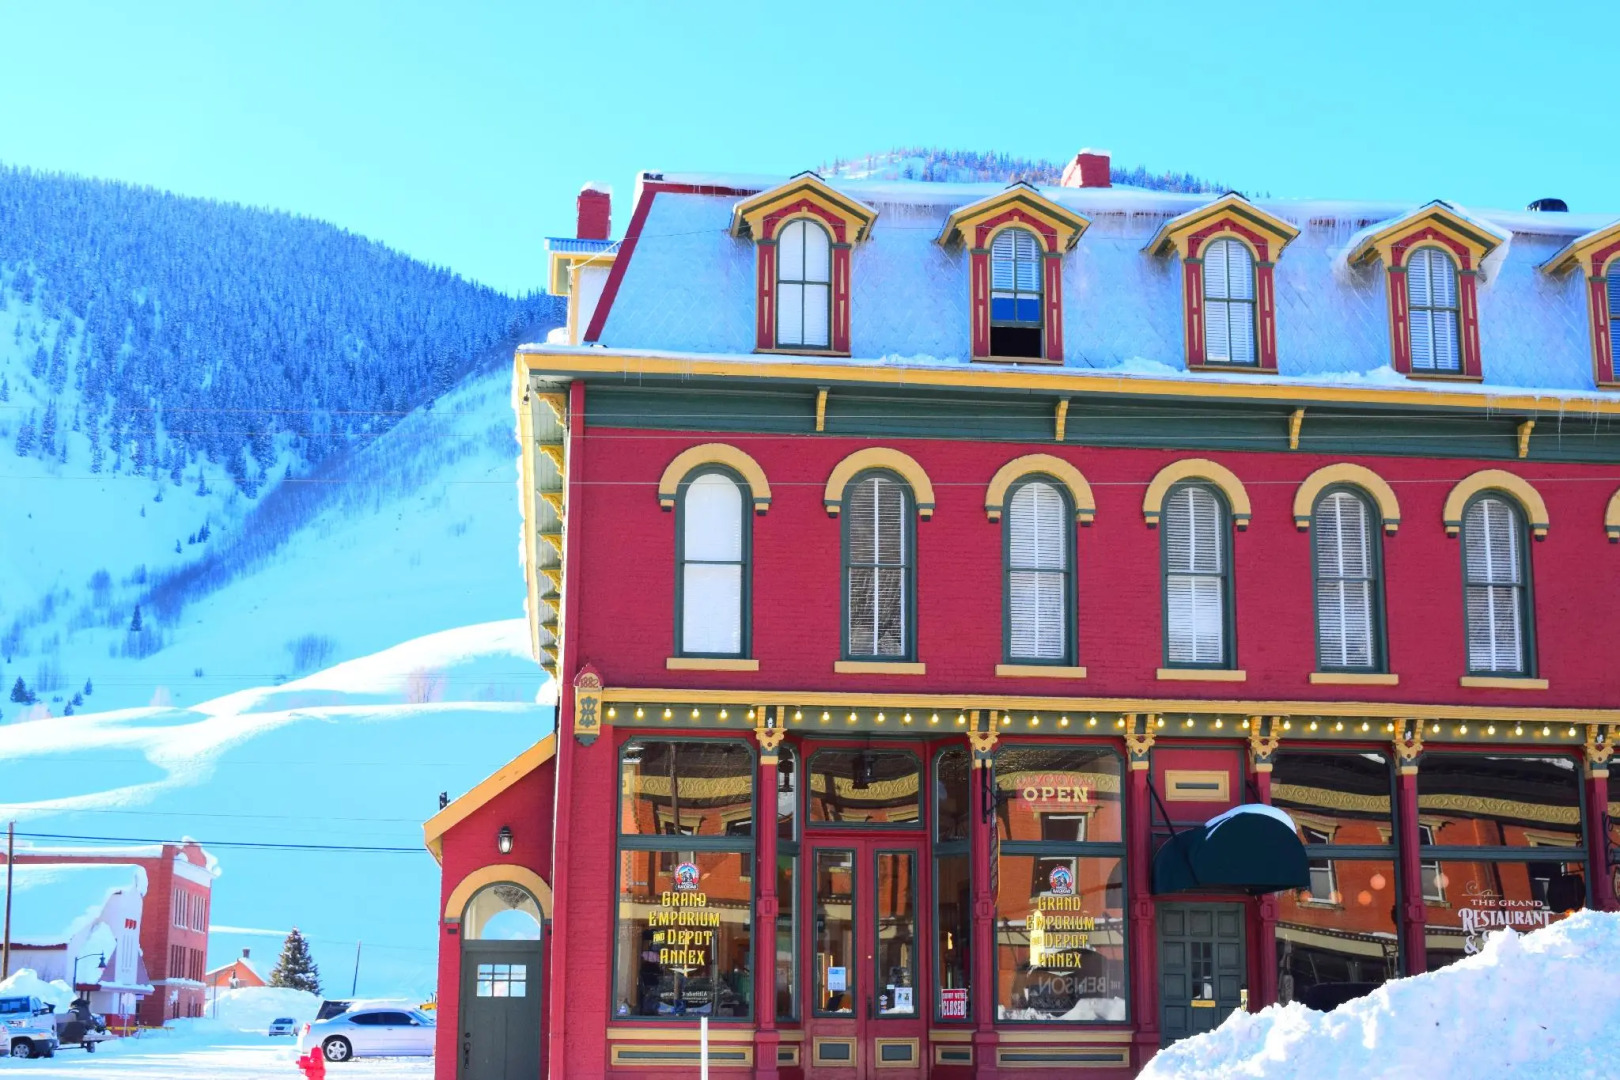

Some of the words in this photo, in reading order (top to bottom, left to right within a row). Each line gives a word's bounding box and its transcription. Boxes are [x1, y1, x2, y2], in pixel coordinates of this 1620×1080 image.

[1023, 786, 1088, 802] OPEN
[662, 891, 706, 907] GRAND
[1038, 896, 1081, 911] GRAND
[1471, 899, 1496, 907] THE
[1499, 899, 1543, 907] GRAND
[648, 911, 720, 927] EMPORIUM
[1026, 914, 1095, 931] EMPORIUM
[1458, 908, 1554, 935] RESTAURANT
[667, 929, 713, 945] DEPOT
[1045, 932, 1088, 949] DEPOT
[660, 948, 705, 966] ANNEX
[1037, 952, 1082, 968] ANNEX
[942, 1000, 965, 1016] CLOSED
